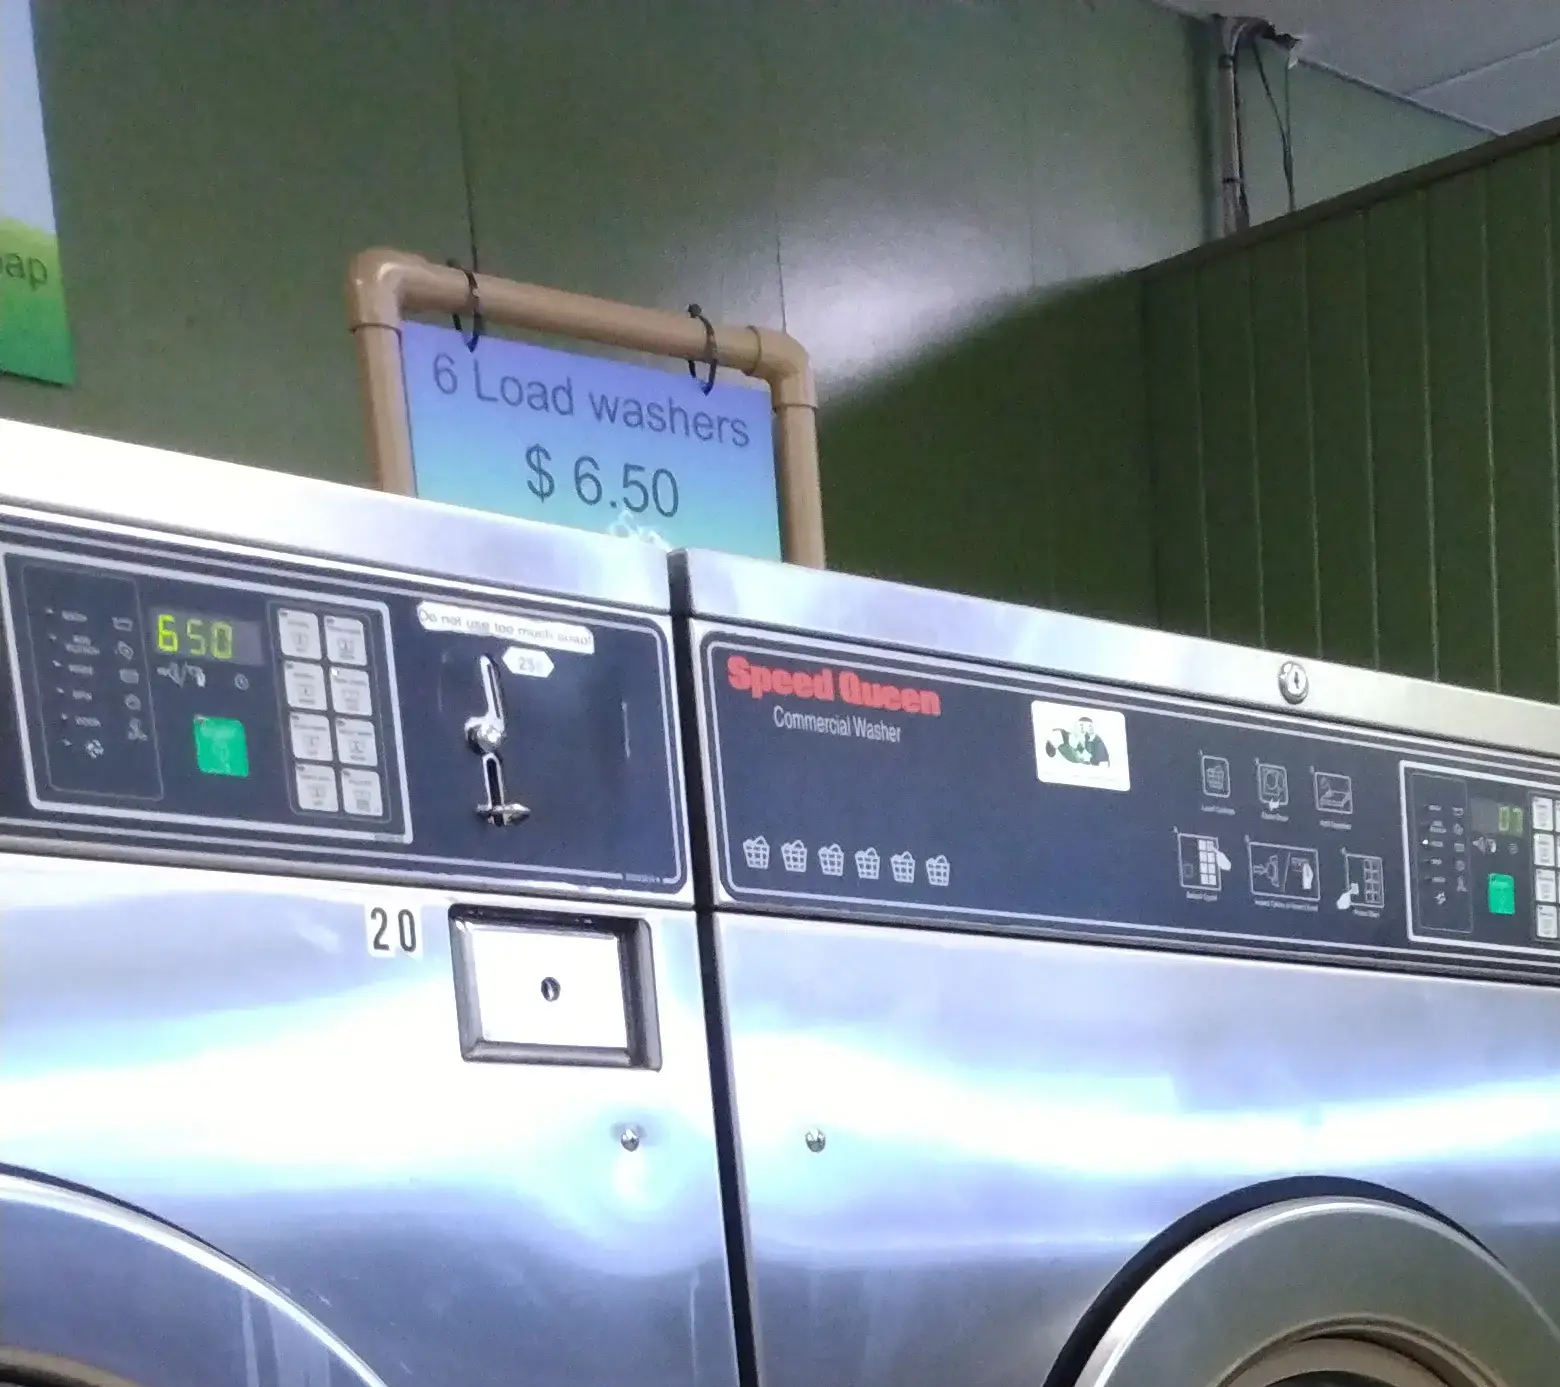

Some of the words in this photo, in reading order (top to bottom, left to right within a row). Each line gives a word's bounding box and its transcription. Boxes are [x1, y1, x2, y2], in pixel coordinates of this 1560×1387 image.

[0, 252, 48, 291] ap
[433, 354, 458, 395] 6
[474, 360, 573, 416] Load
[589, 391, 749, 447] washers
[525, 443, 555, 502] $
[574, 456, 679, 518] 6.50
[157, 613, 233, 659] 650
[419, 609, 437, 623] Do
[442, 614, 461, 626] not
[466, 619, 490, 632] use
[494, 622, 514, 634] too
[518, 627, 554, 640] much
[727, 655, 835, 701] Speed
[838, 671, 941, 716] Queen
[773, 705, 851, 736] Commercial
[852, 715, 901, 743] Washer
[370, 906, 416, 953] 20
